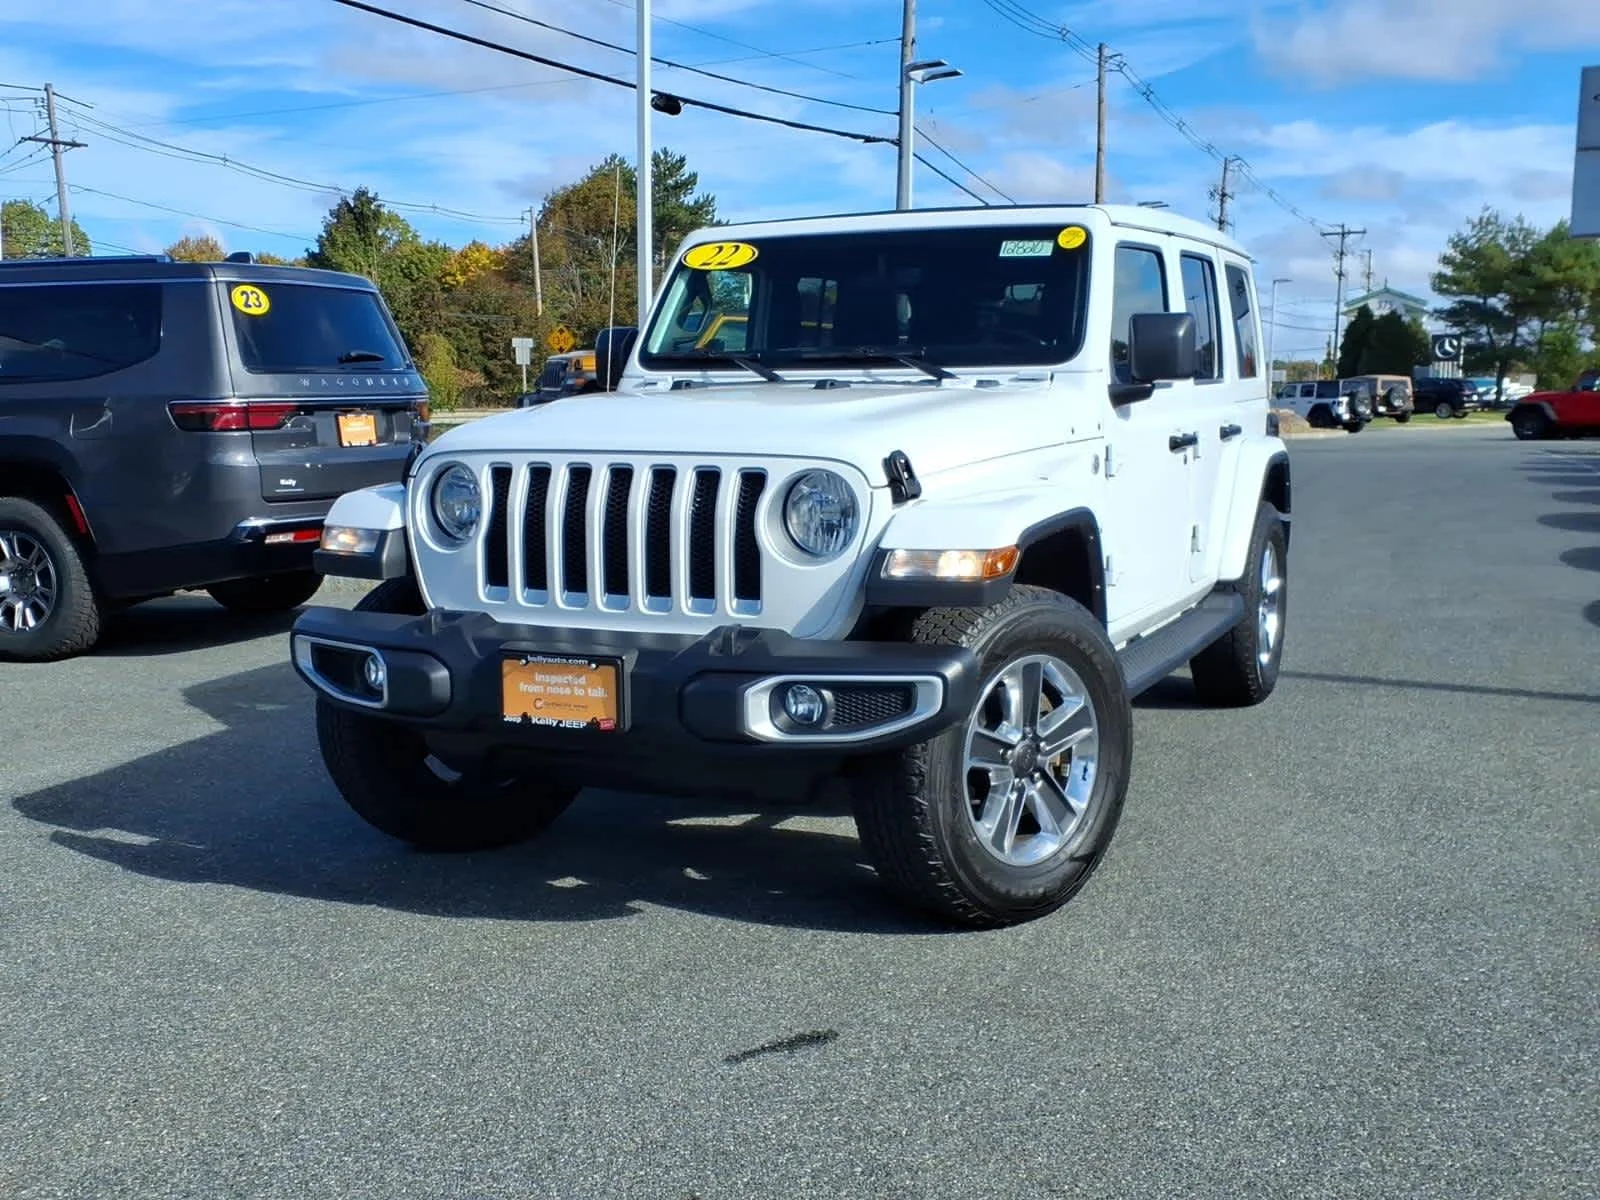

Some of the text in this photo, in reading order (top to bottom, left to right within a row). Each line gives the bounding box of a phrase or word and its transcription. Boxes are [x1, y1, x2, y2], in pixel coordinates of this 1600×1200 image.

[699, 244, 740, 267] 22
[240, 290, 263, 308] 23
[535, 672, 587, 686] Inspected
[519, 683, 544, 694] from
[546, 686, 572, 695] nose
[574, 686, 585, 696] to
[530, 716, 558, 728] Kelly
